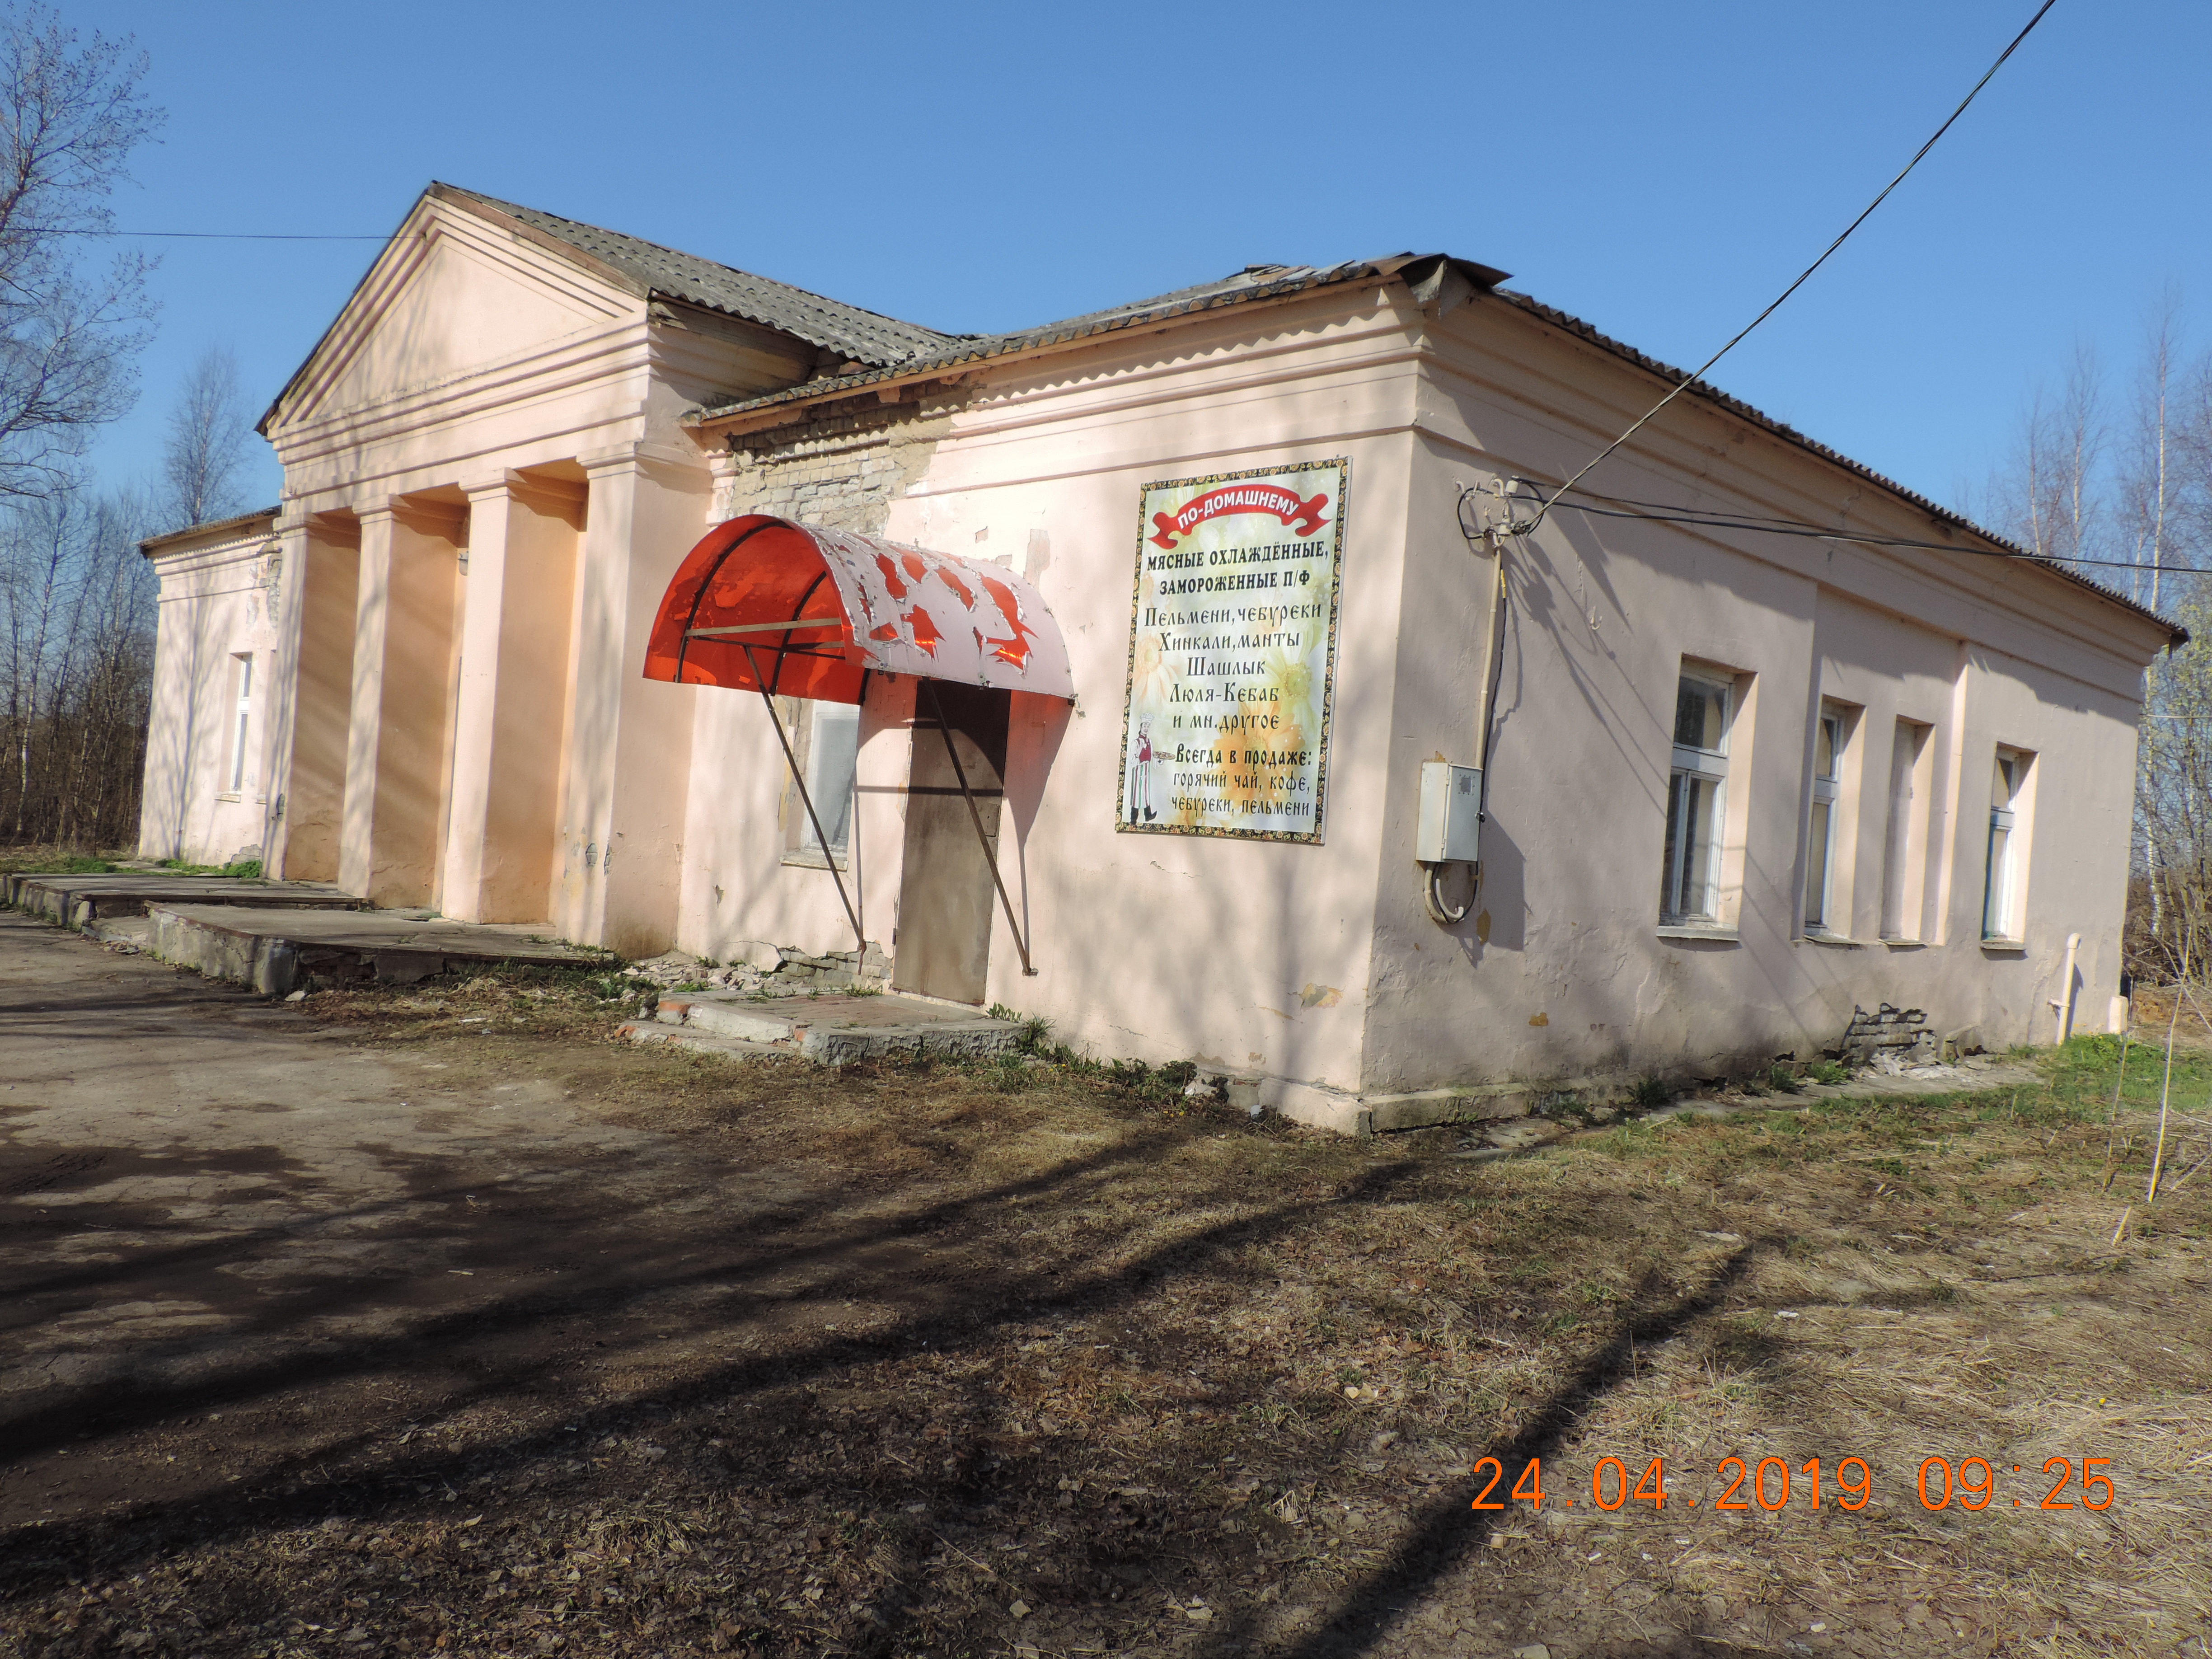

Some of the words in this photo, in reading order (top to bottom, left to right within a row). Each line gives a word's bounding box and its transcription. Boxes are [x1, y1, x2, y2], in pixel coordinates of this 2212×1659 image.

[1177, 490, 1299, 530] ПО-ДОМАШНЕМУ
[1147, 552, 1204, 571] МЯСНЫЕ
[1209, 541, 1328, 566] ОХЛАЖДЁННЫЕ,
[1160, 572, 1278, 595] ЗАМОРОЖЕННЫЕ
[1284, 570, 1310, 587] П/Ф
[1186, 657, 1266, 676] Шашлык
[1170, 682, 1279, 703] Люля-Кебаб
[1173, 715, 1181, 729] и
[1175, 743, 1223, 769] Всегда
[1229, 750, 1237, 764] в
[1244, 750, 1312, 772] продаже:
[1173, 770, 1227, 792] горячий
[1234, 771, 1262, 792] чай,
[1270, 770, 1310, 797] кофе,
[1171, 795, 1234, 817] чебуреки,
[1242, 799, 1310, 816] пельмени
